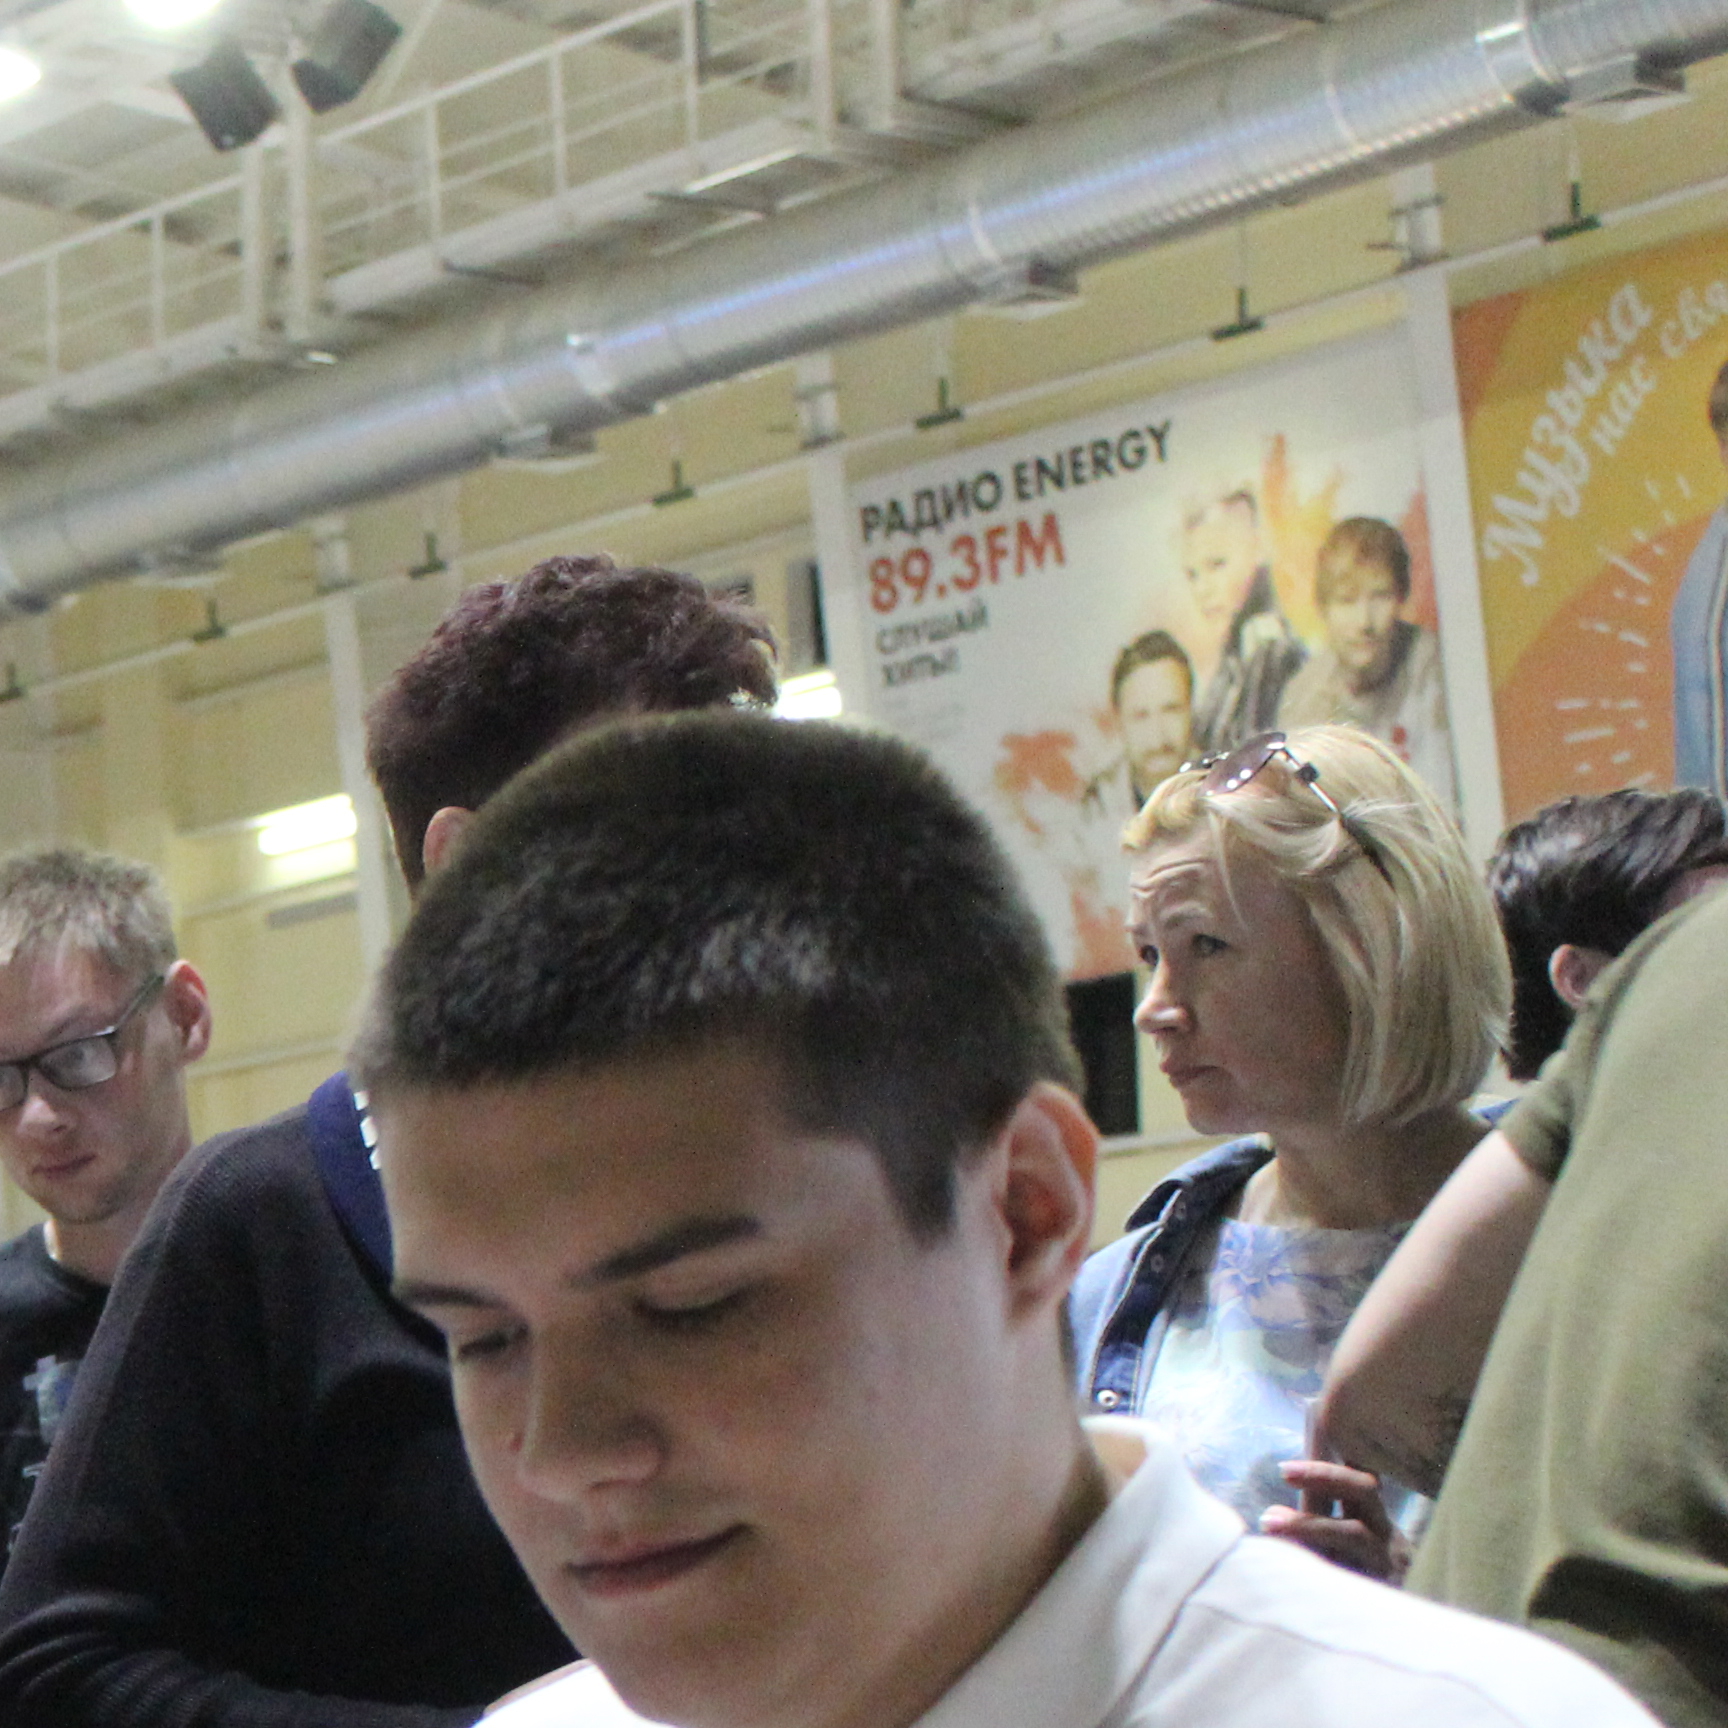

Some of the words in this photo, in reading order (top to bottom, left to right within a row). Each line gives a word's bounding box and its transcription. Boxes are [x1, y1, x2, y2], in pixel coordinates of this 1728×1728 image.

[1483, 282, 1653, 586] Музыка
[1591, 355, 1657, 457] нас
[859, 470, 1003, 543] РАДИО
[1012, 419, 1173, 502] ENERGY
[868, 509, 1067, 615] 89.3FM
